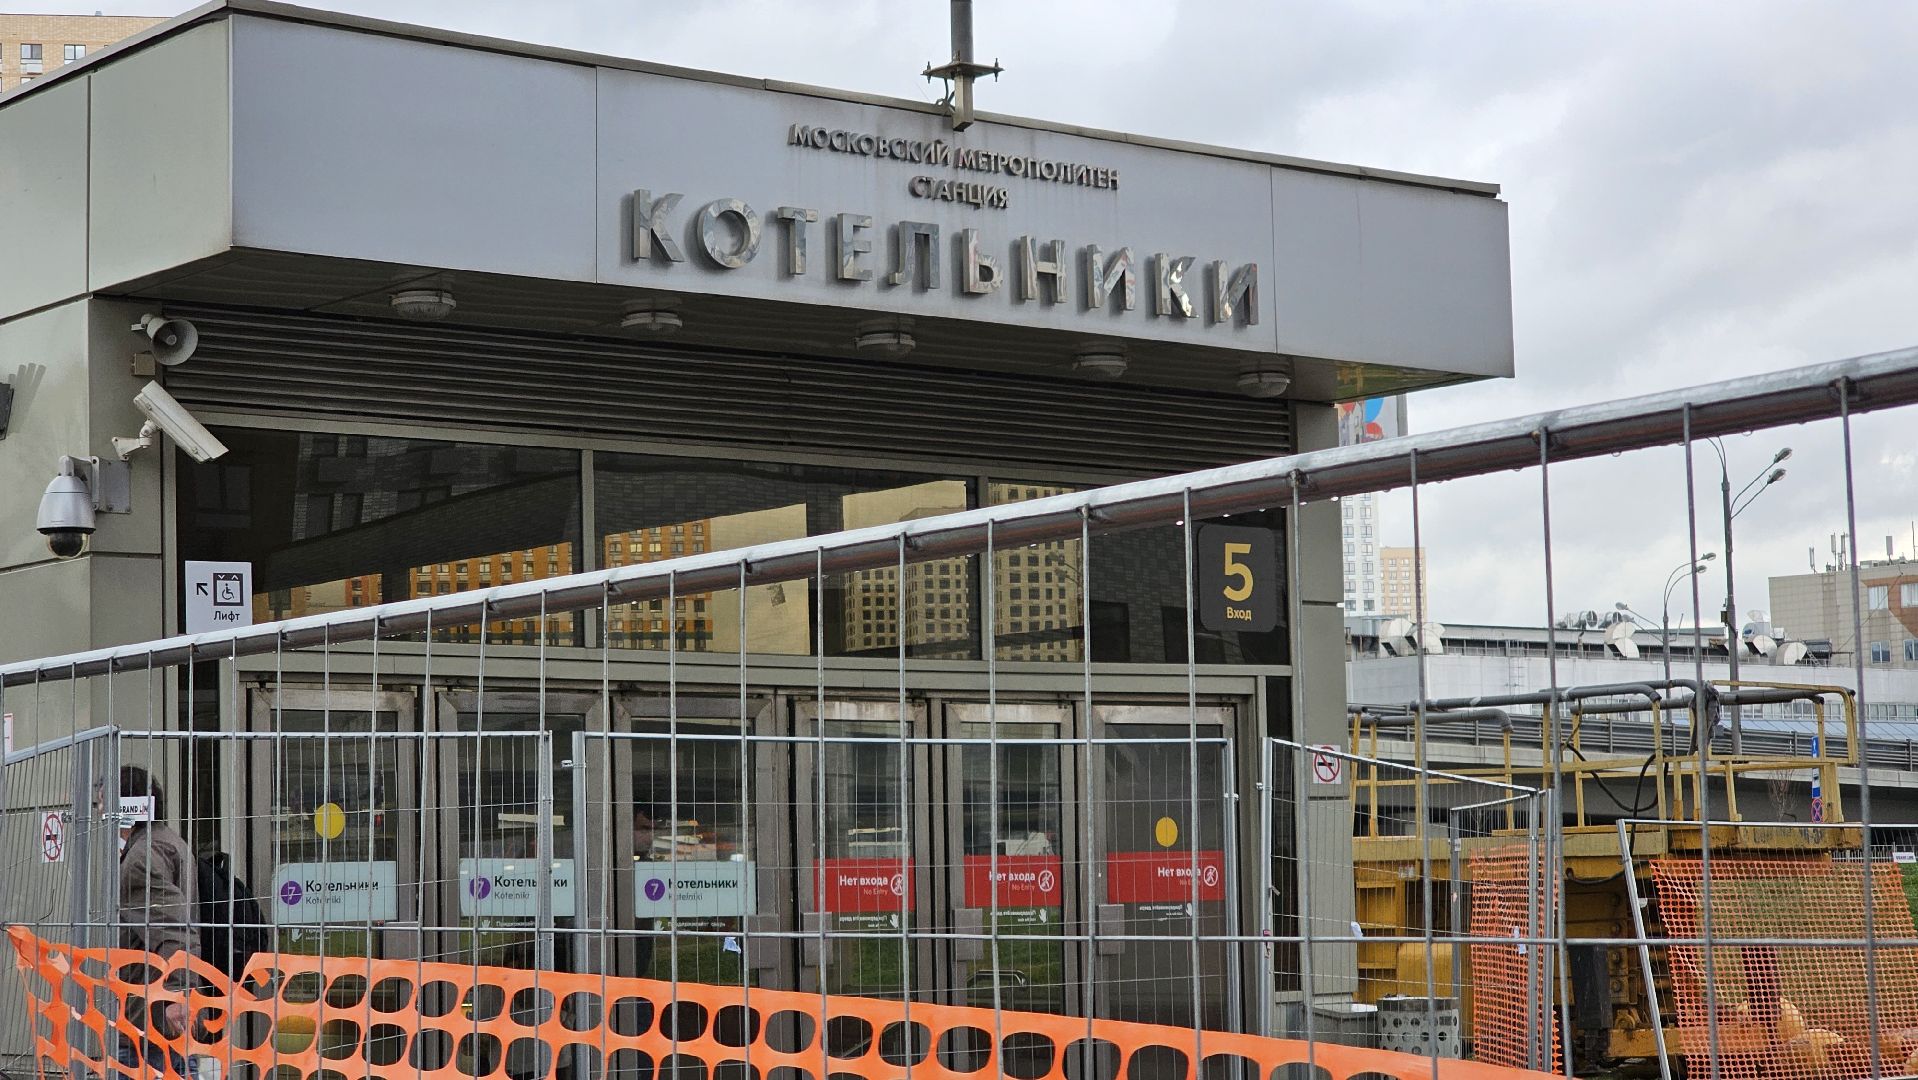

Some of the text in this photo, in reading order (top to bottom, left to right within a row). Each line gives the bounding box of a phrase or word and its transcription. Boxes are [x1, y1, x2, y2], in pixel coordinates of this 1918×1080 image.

[788, 123, 1120, 190] МОСКОВСКИЙ МЕТРОПОЛИТЕН
[908, 175, 1009, 209] СТАНЦИЯ
[629, 187, 1260, 326] КОТЕЛЬНИКИ
[1223, 542, 1254, 602] 5
[213, 610, 241, 623] Лифт
[1226, 606, 1252, 621] Вход
[1008, 872, 1036, 883] входа
[1157, 866, 1201, 879] Нет вхоа
[494, 875, 568, 888] Котельки
[839, 874, 888, 888] Нет входа
[288, 886, 297, 900] 7
[494, 891, 530, 900] Koteniki
[650, 883, 659, 896] 7
[668, 892, 703, 900] telniki
